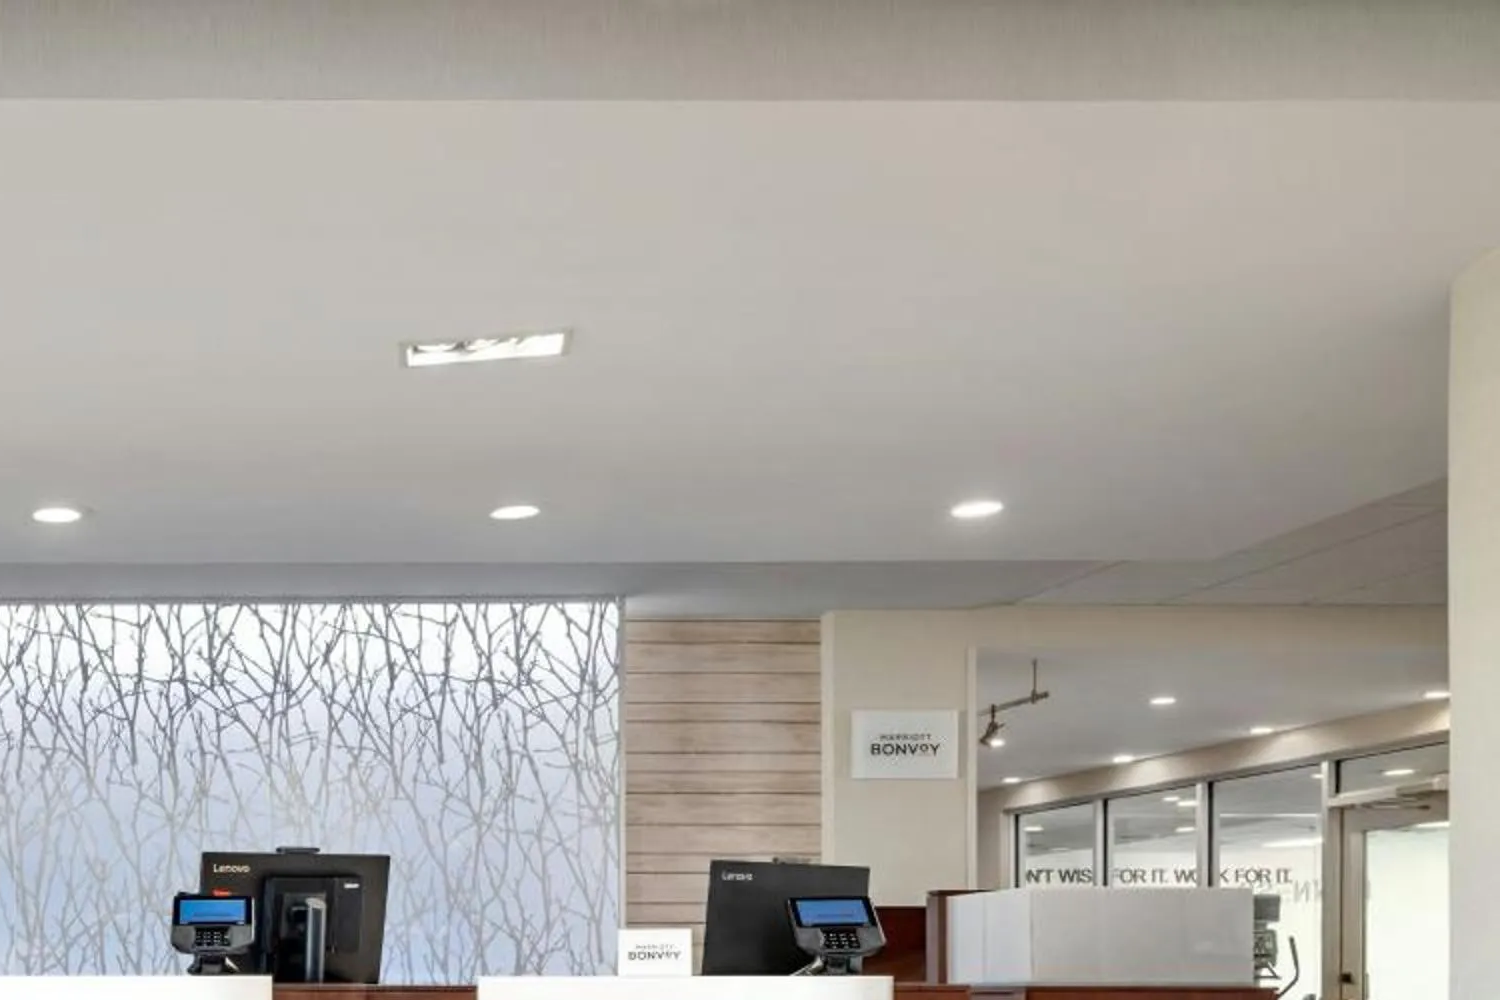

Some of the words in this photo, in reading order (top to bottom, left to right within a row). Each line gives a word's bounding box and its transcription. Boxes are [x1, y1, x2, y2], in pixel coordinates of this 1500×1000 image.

[870, 743, 941, 756] BONVOY
[213, 863, 251, 873] Lenovo
[1058, 868, 1093, 883] WIS
[1235, 868, 1271, 884] FOR
